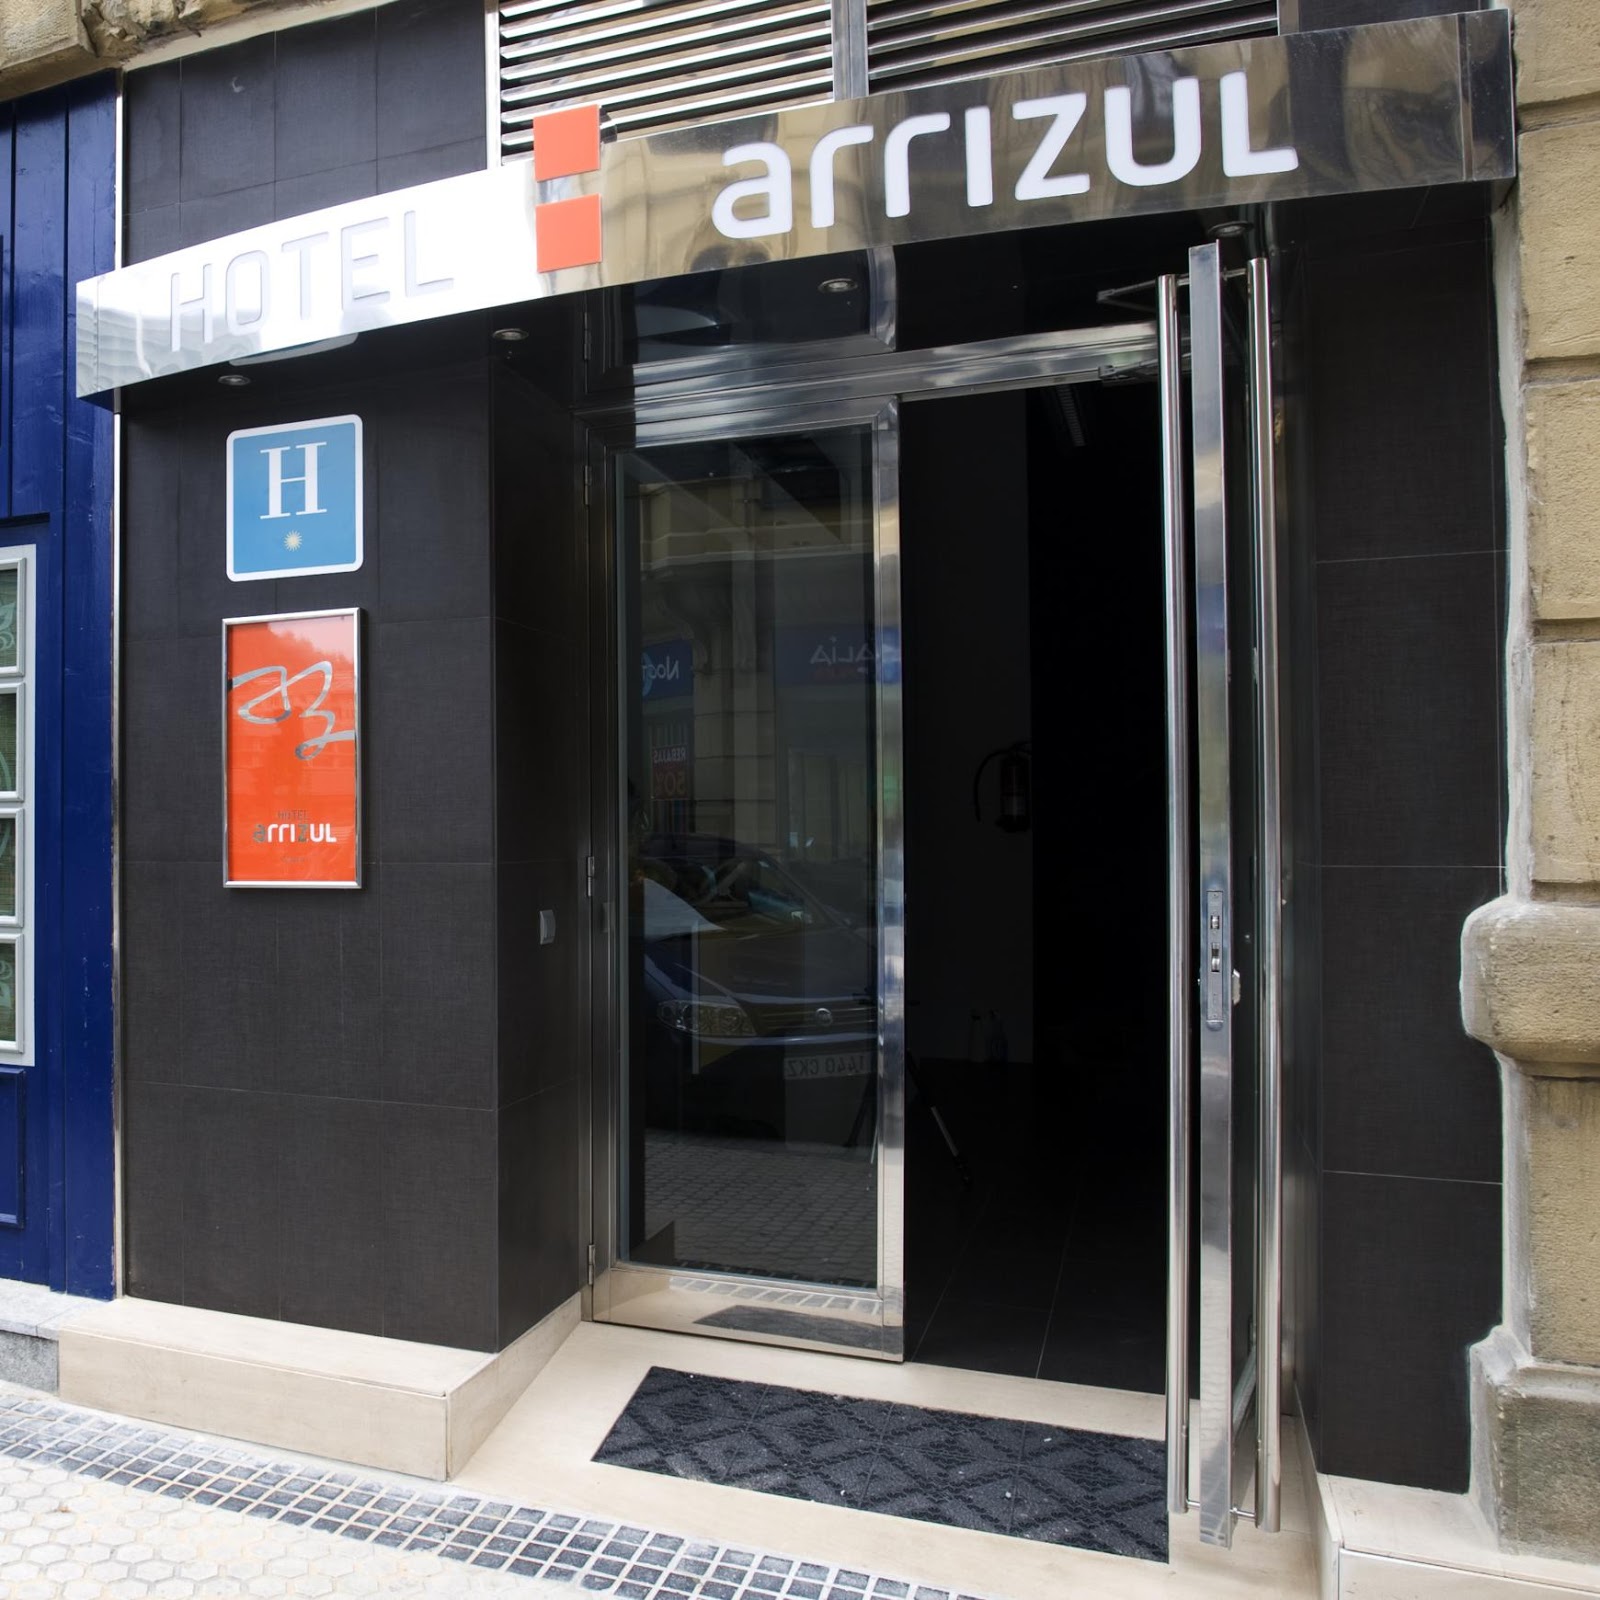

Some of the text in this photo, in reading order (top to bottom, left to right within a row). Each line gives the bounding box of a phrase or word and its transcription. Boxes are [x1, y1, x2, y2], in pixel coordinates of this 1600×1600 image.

[170, 210, 454, 353] HOTEL
[259, 442, 328, 520] H
[277, 809, 308, 820] HOTEL
